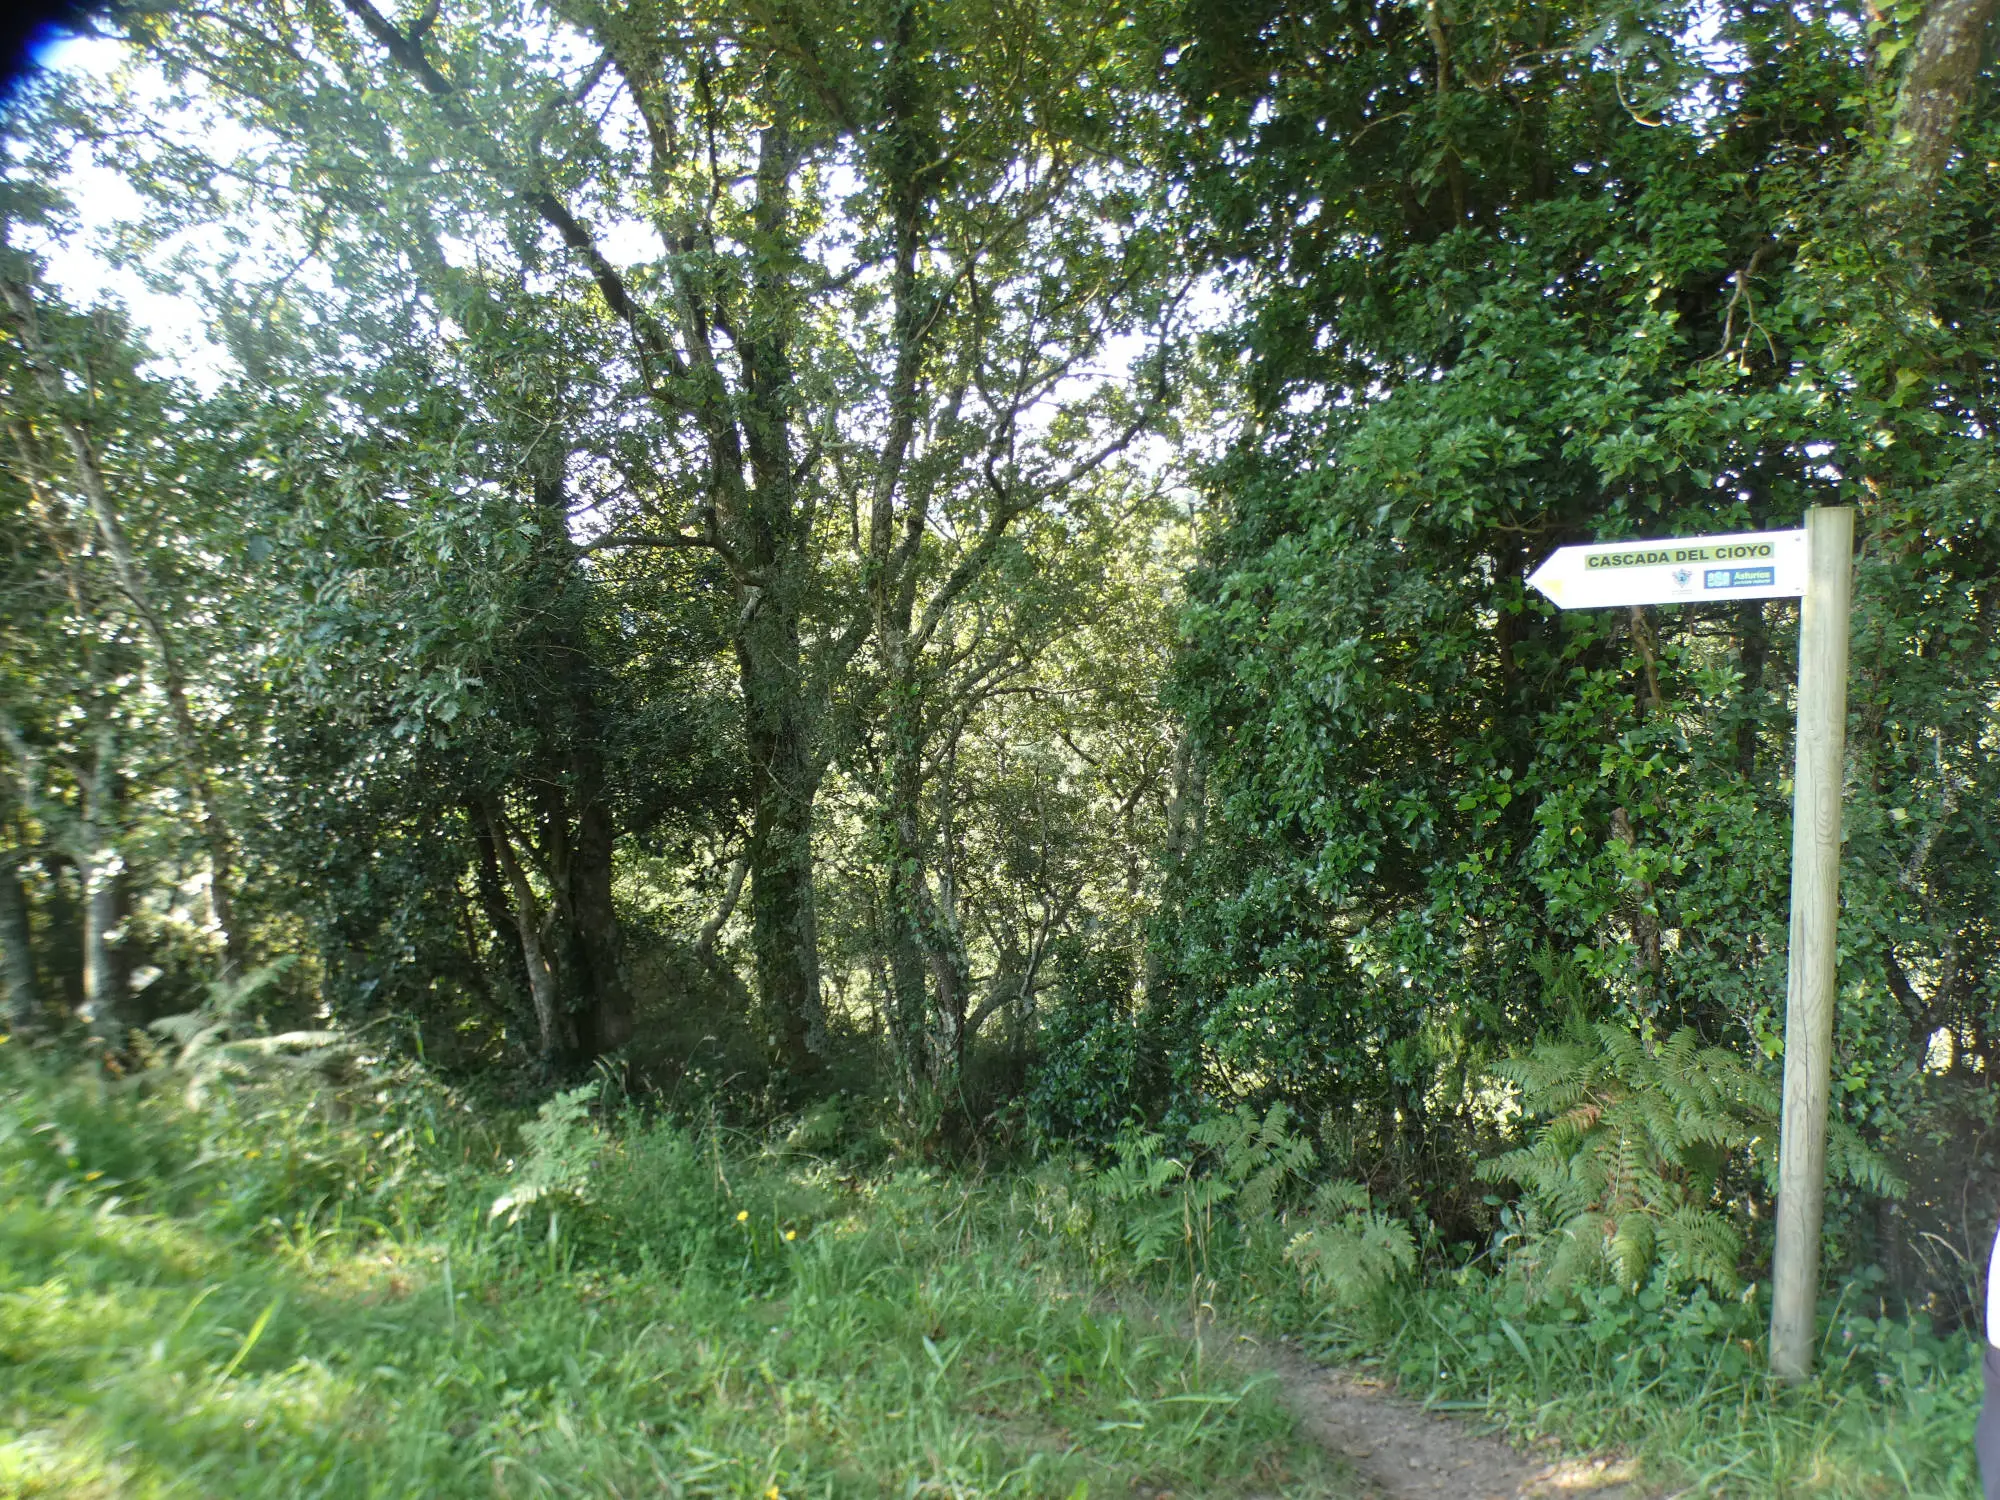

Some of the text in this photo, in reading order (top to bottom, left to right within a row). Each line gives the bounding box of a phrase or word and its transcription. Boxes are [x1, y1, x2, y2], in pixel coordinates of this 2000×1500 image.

[1588, 544, 1771, 568] CASCADA DEL CIOYO
